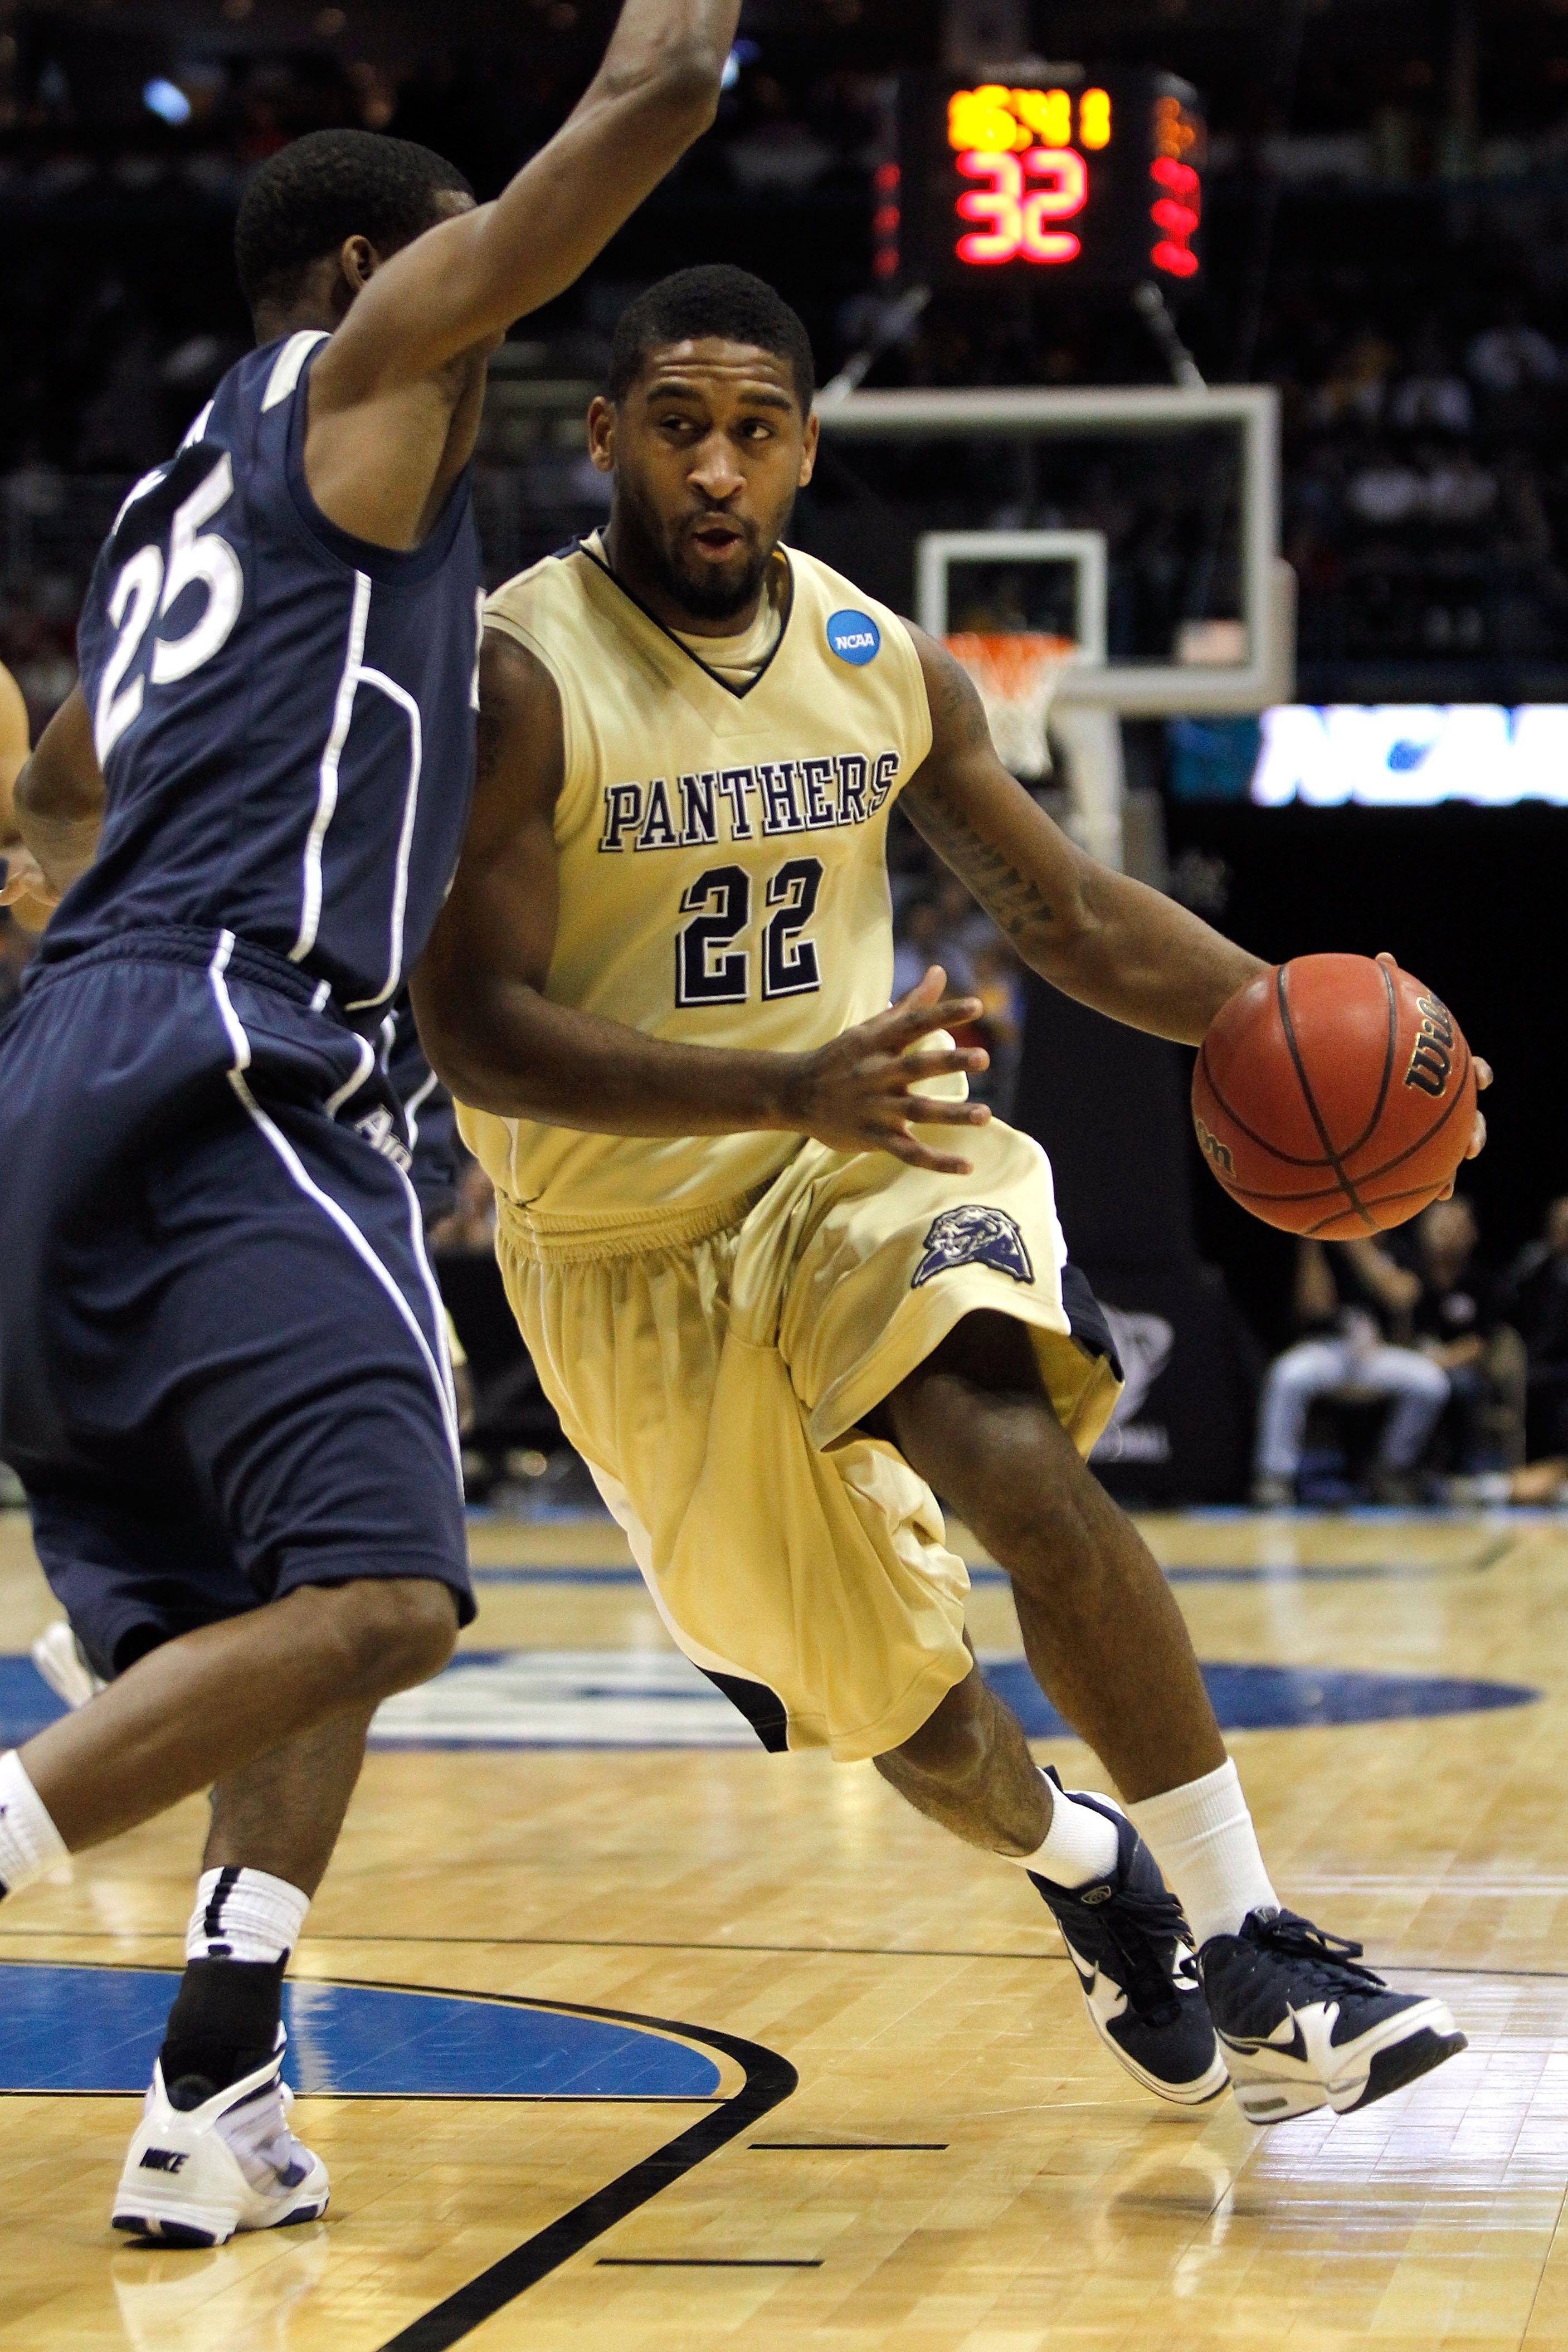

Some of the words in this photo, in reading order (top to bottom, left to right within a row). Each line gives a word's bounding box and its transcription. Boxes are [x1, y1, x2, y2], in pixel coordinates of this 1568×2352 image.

[956, 147, 1087, 264] 32
[94, 450, 244, 771] 25
[835, 632, 875, 650] NCAA
[599, 750, 900, 851] PANTHERS
[675, 856, 826, 1007] 22
[139, 2148, 190, 2173] NIKE
